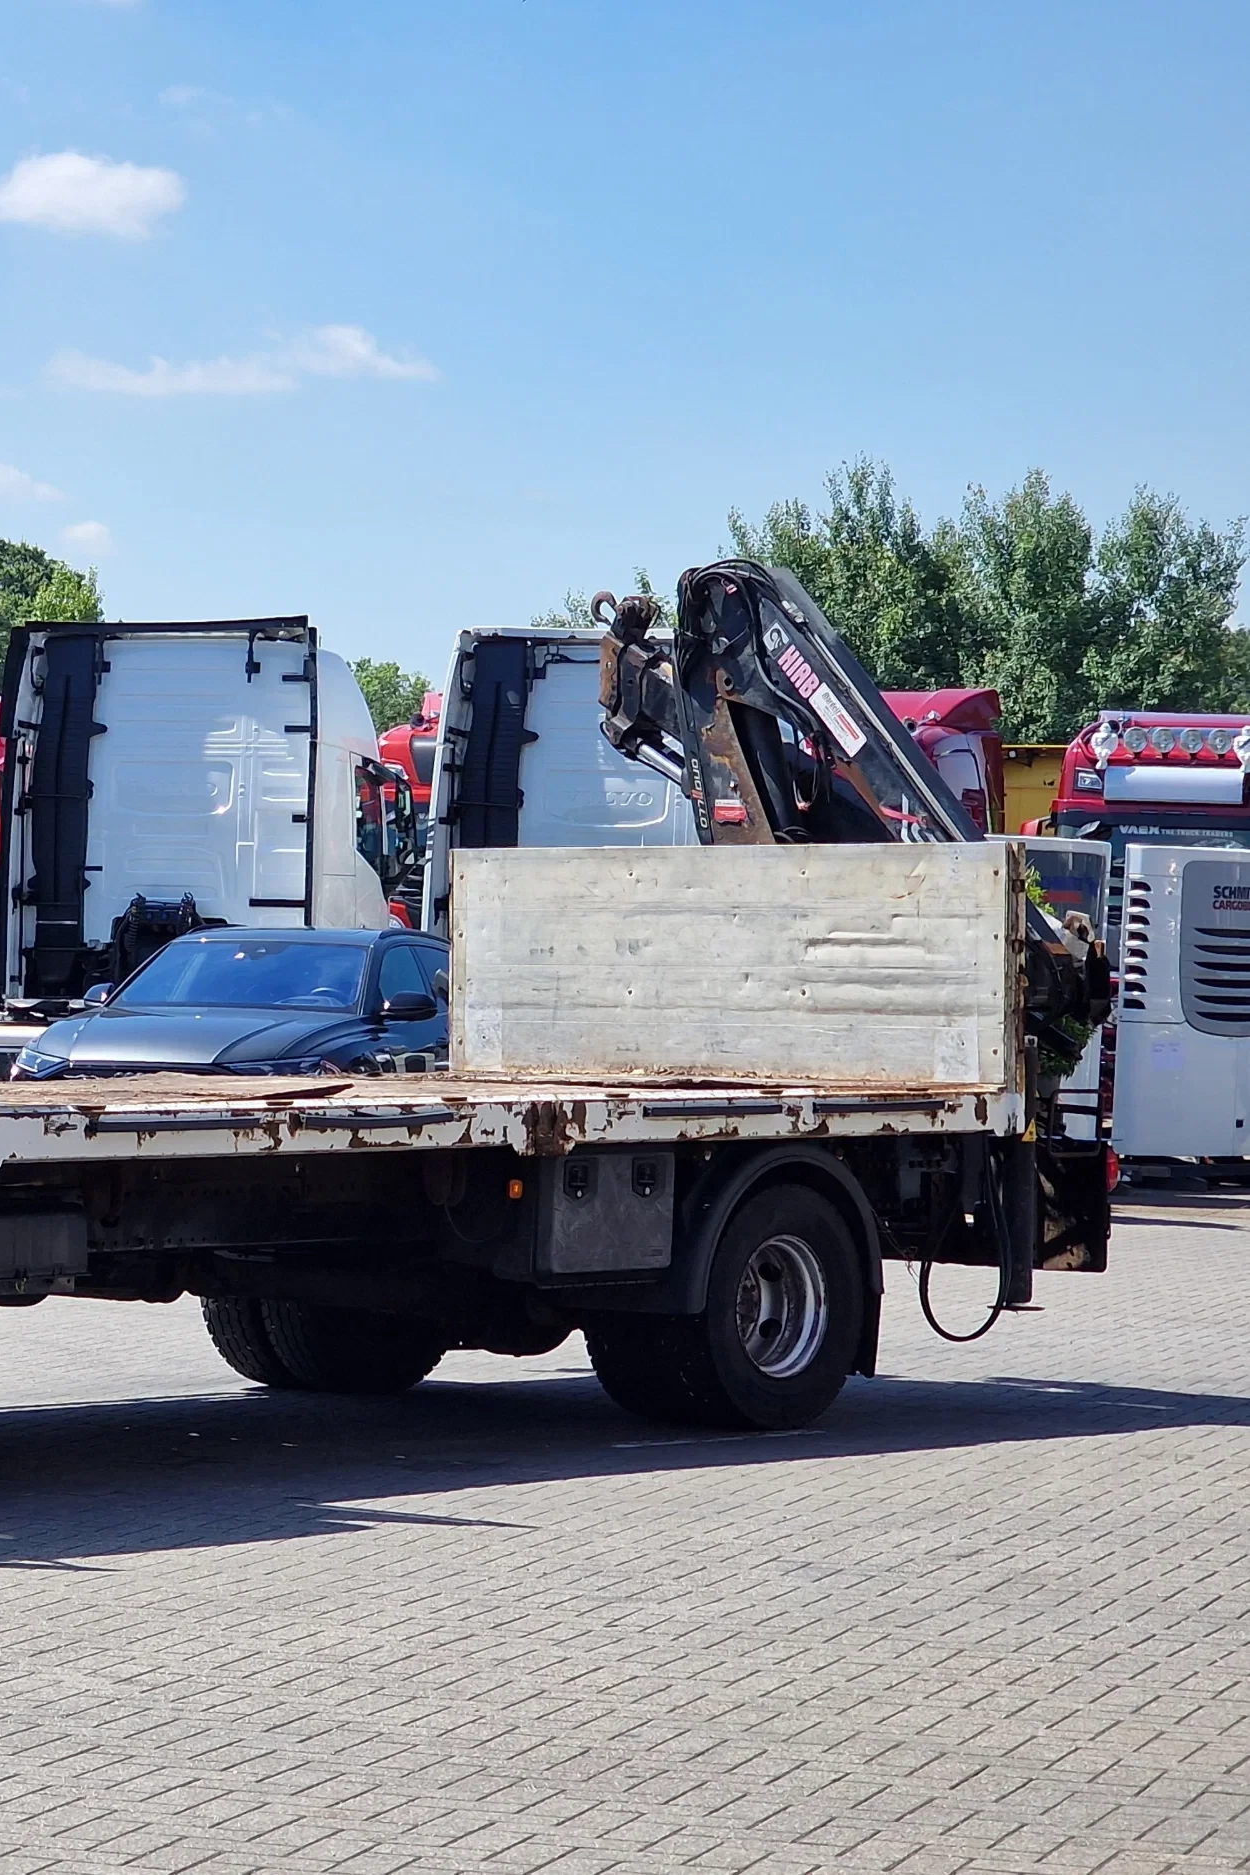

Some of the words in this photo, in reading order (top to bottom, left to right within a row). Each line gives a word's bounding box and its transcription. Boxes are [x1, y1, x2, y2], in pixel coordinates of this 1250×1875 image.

[777, 644, 820, 698] HIAB
[1118, 824, 1160, 835] VAEX
[1161, 828, 1175, 836] THE
[1177, 828, 1199, 837] TRUCK
[1202, 829, 1234, 838] TRADERS
